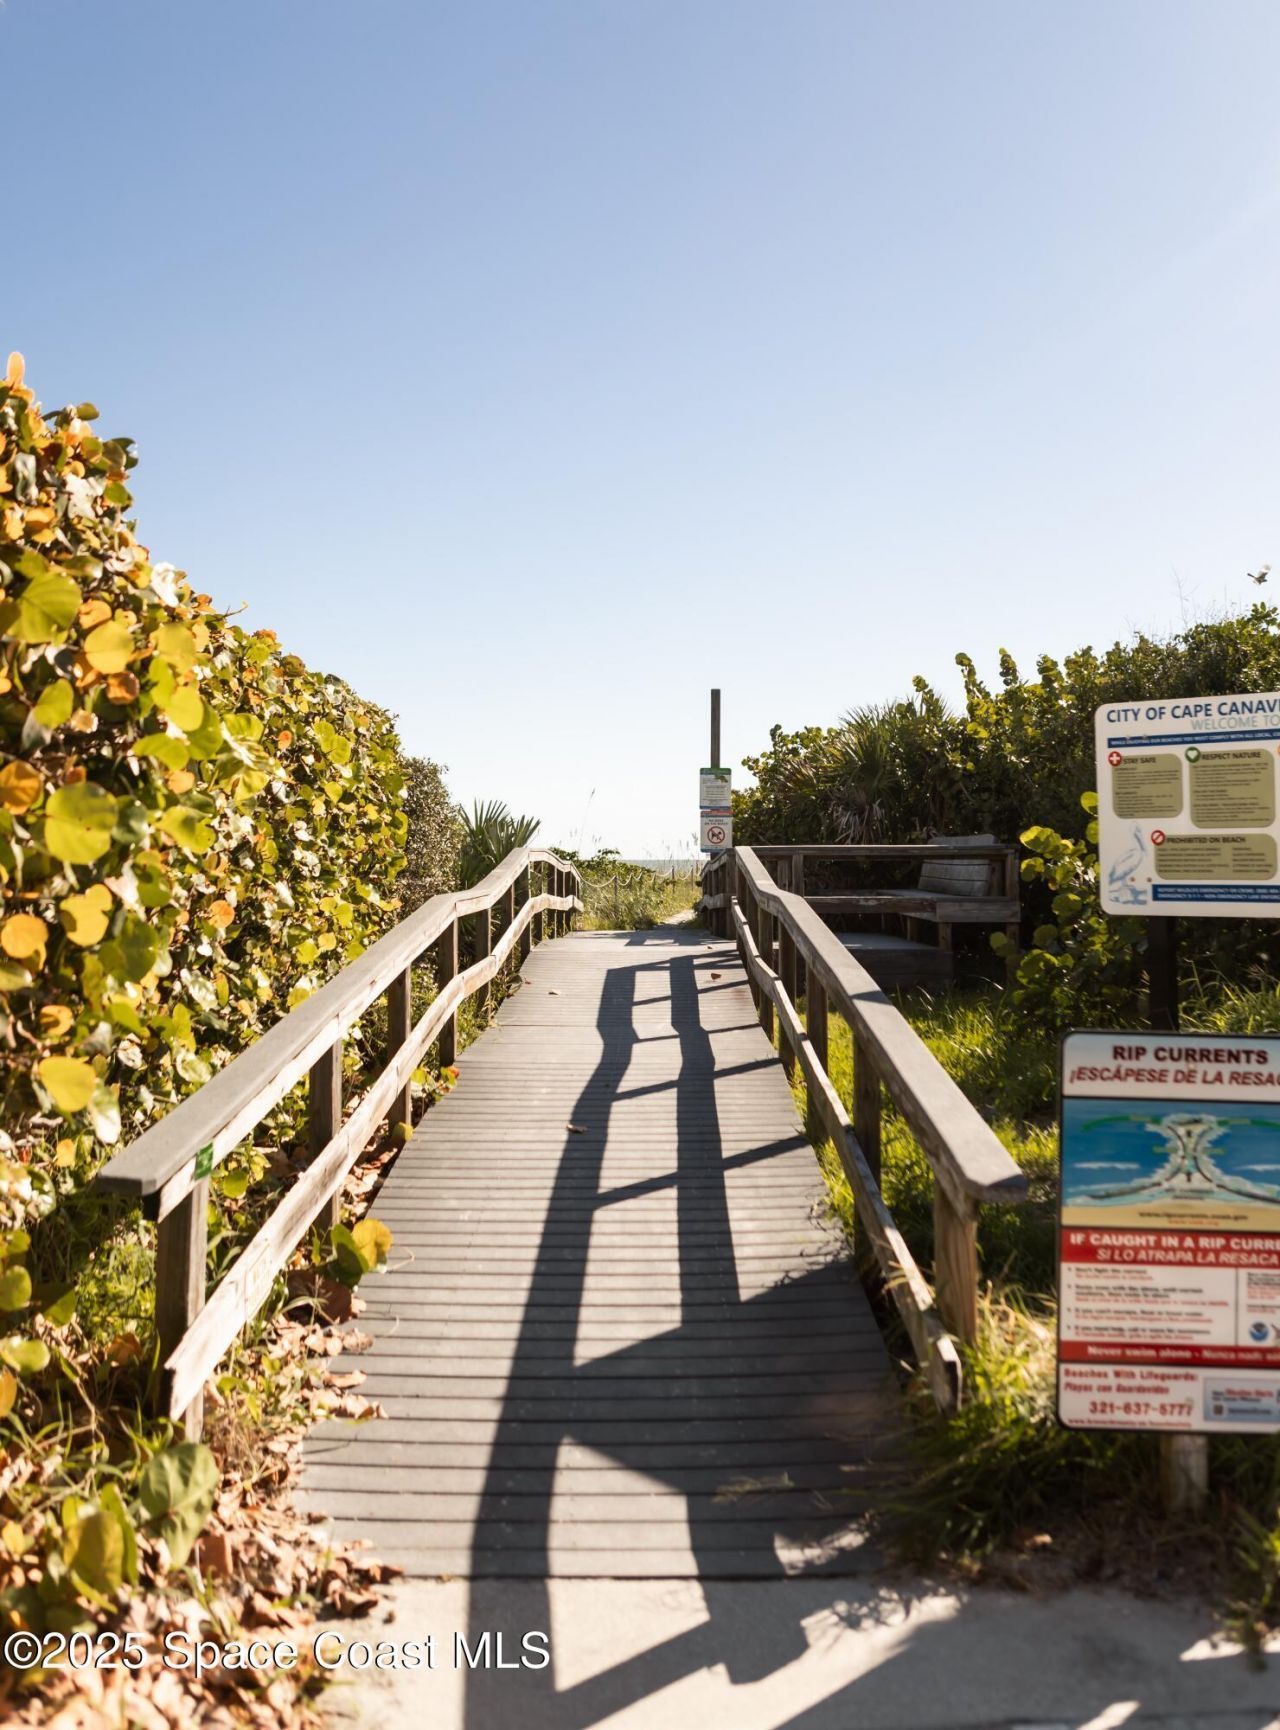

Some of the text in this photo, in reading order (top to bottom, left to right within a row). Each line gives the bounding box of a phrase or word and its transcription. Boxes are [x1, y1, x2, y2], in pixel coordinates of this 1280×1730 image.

[1106, 698, 1280, 723] CITY OF CAPE CANAV
[1191, 713, 1280, 731] WELCOME TO
[1123, 757, 1138, 765] STAY
[1201, 752, 1261, 761] RESPECT NATURE
[1112, 1046, 1269, 1064] RIP CURRENTS
[1069, 1065, 1169, 1084] ¡ESCÁPESE
[1173, 1069, 1198, 1083] DE
[1202, 1070, 1223, 1084] LA
[1070, 1233, 1085, 1245] IF
[1089, 1234, 1157, 1247] CAUGHT
[1161, 1235, 1179, 1247] IN
[1183, 1236, 1195, 1248] A
[1199, 1237, 1226, 1249] RIP
[1096, 1248, 1279, 1265] SI LO ATRAPA LA RESACA
[1087, 1345, 1122, 1357] Never
[1125, 1347, 1157, 1358] swim
[1159, 1347, 1193, 1359] alone
[1063, 1367, 1108, 1379] Beaches
[1113, 1370, 1136, 1380] With
[1063, 1382, 1093, 1394] Playas
[1097, 1384, 1113, 1393] con
